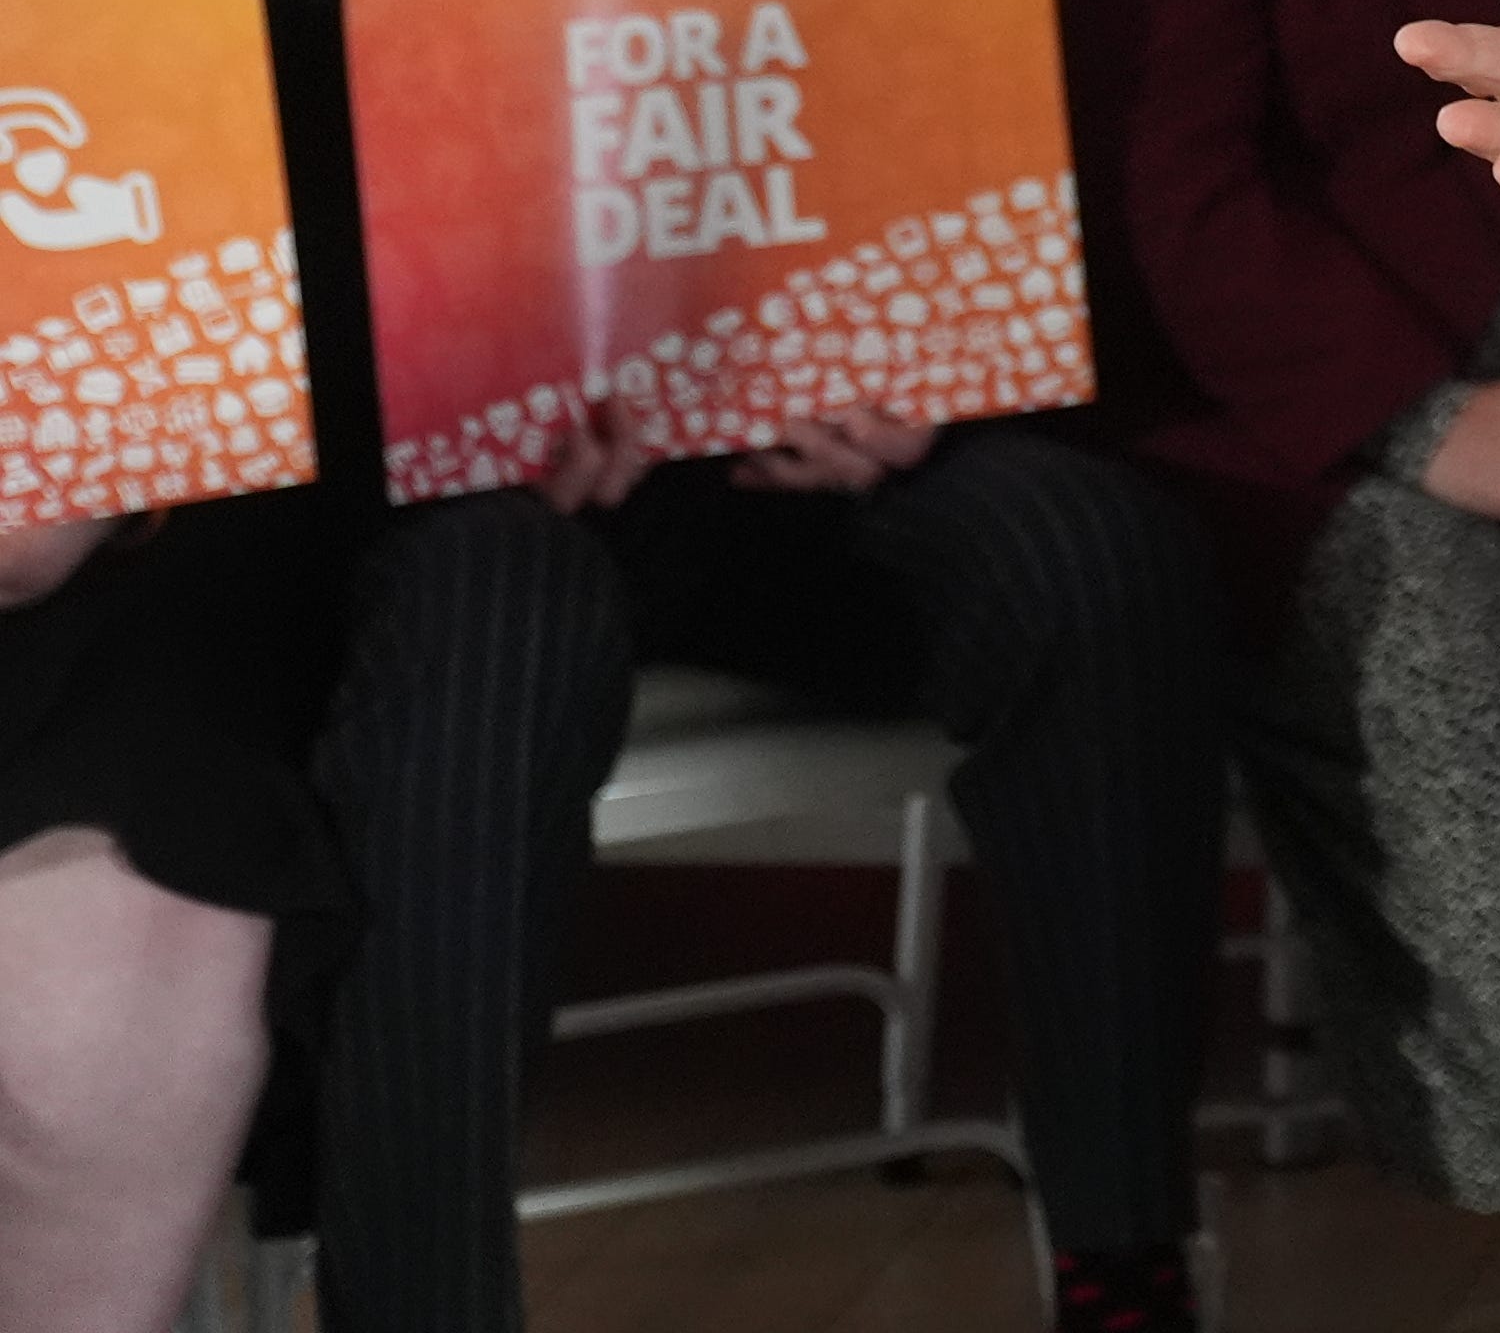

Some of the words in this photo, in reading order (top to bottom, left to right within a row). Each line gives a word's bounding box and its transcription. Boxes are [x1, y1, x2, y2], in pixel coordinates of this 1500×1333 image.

[565, 12, 726, 87] FOR
[741, 1, 810, 71] A
[571, 74, 815, 181] FAIR
[576, 165, 828, 269] DEAL
